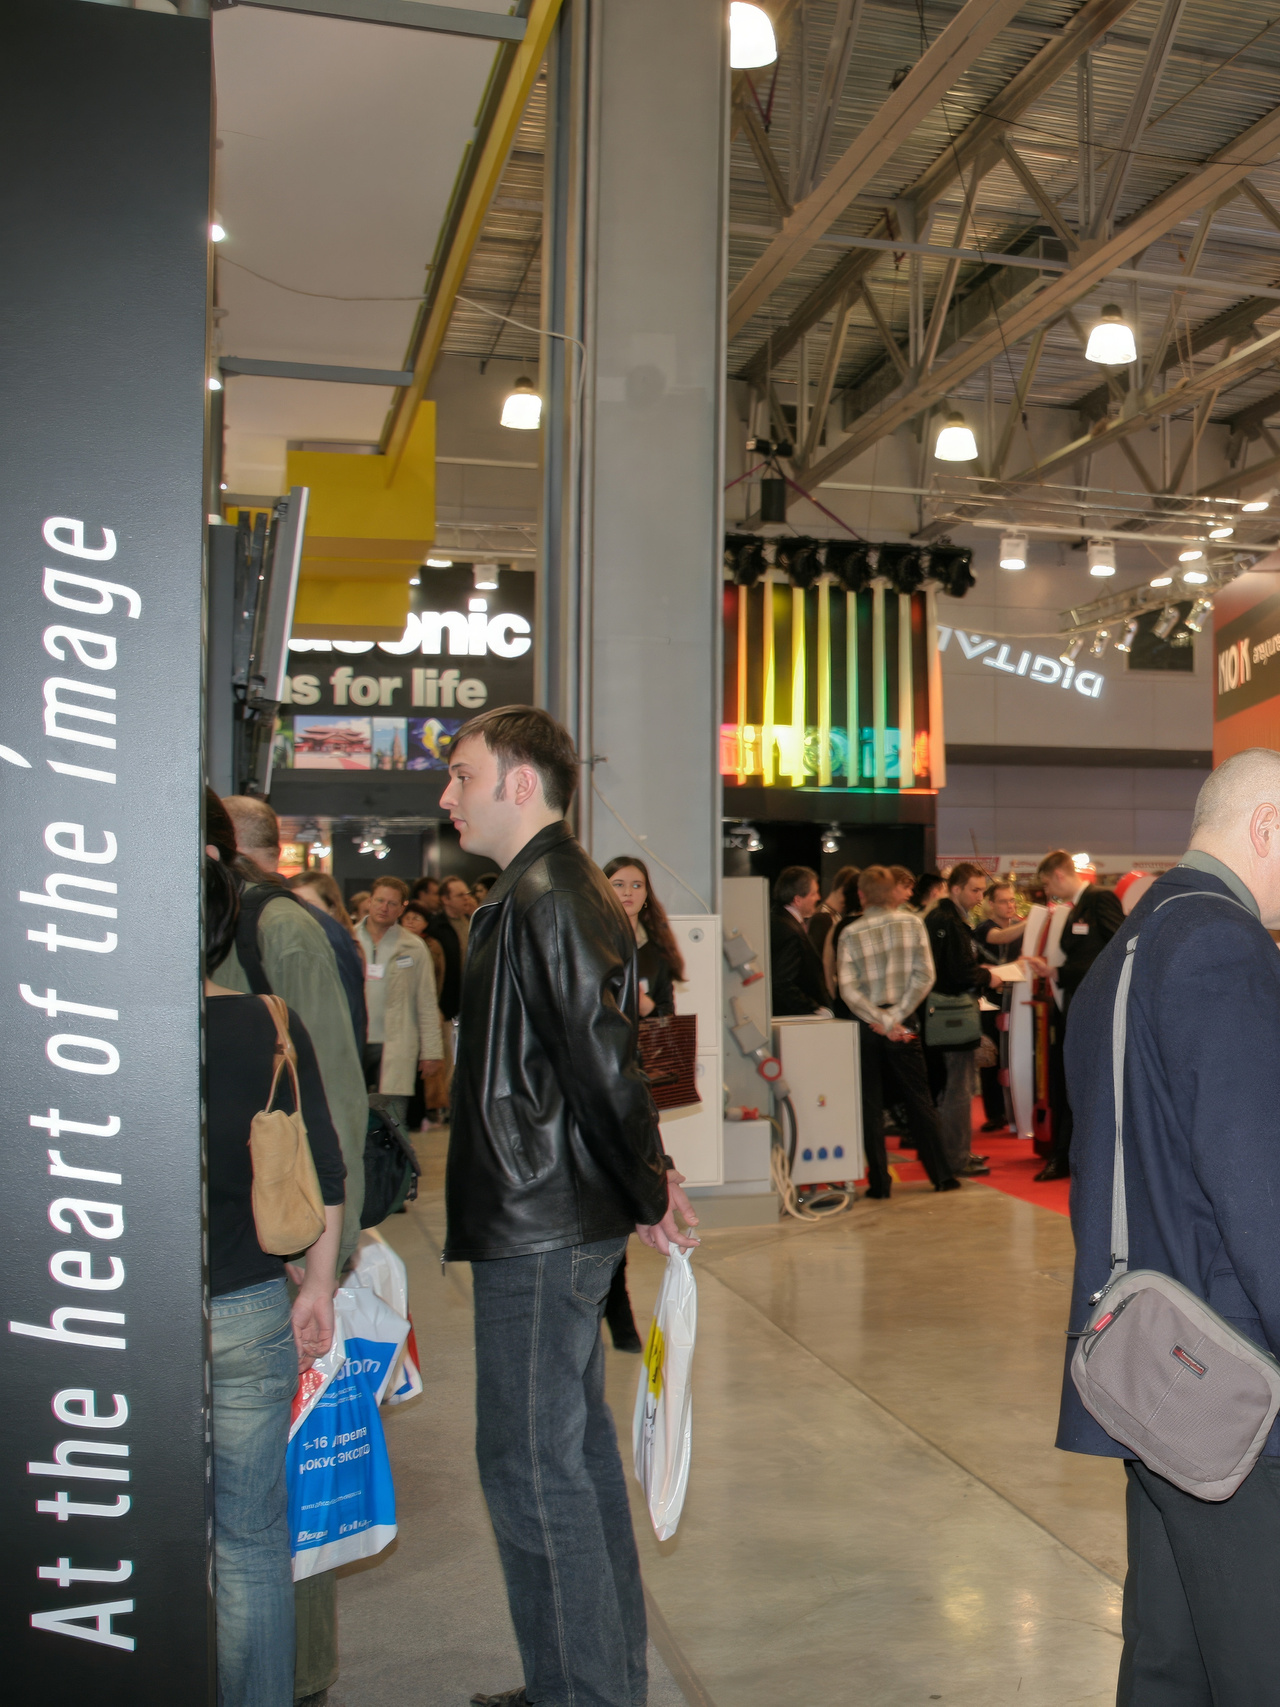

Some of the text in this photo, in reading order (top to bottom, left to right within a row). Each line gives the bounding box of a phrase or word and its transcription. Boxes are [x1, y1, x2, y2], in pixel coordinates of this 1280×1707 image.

[330, 666, 402, 707] for
[411, 667, 488, 709] life
[0, 515, 142, 1652] At the heart of the image
